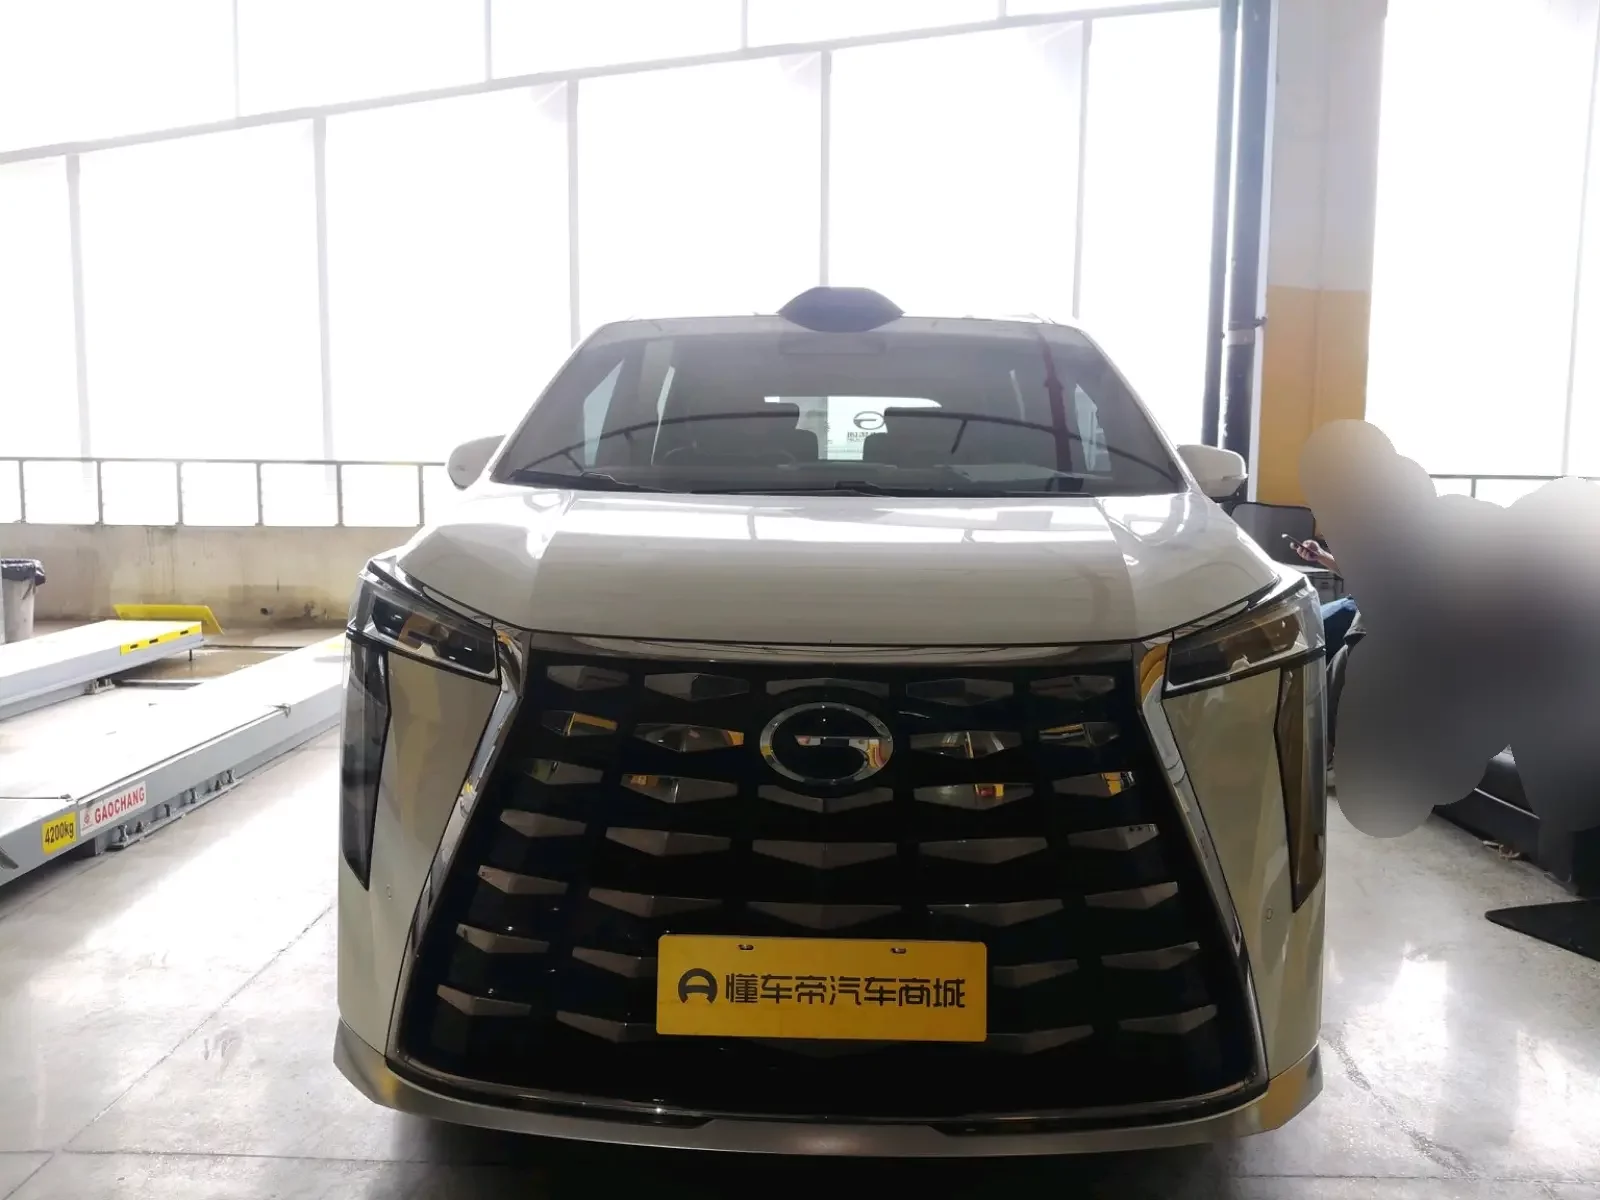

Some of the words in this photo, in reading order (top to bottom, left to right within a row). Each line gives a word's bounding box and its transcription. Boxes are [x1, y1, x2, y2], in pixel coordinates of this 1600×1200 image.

[94, 787, 145, 824] GAOCHANG
[44, 822, 74, 845] 4200kg
[725, 973, 966, 1008] 懂车帝汽车商城
